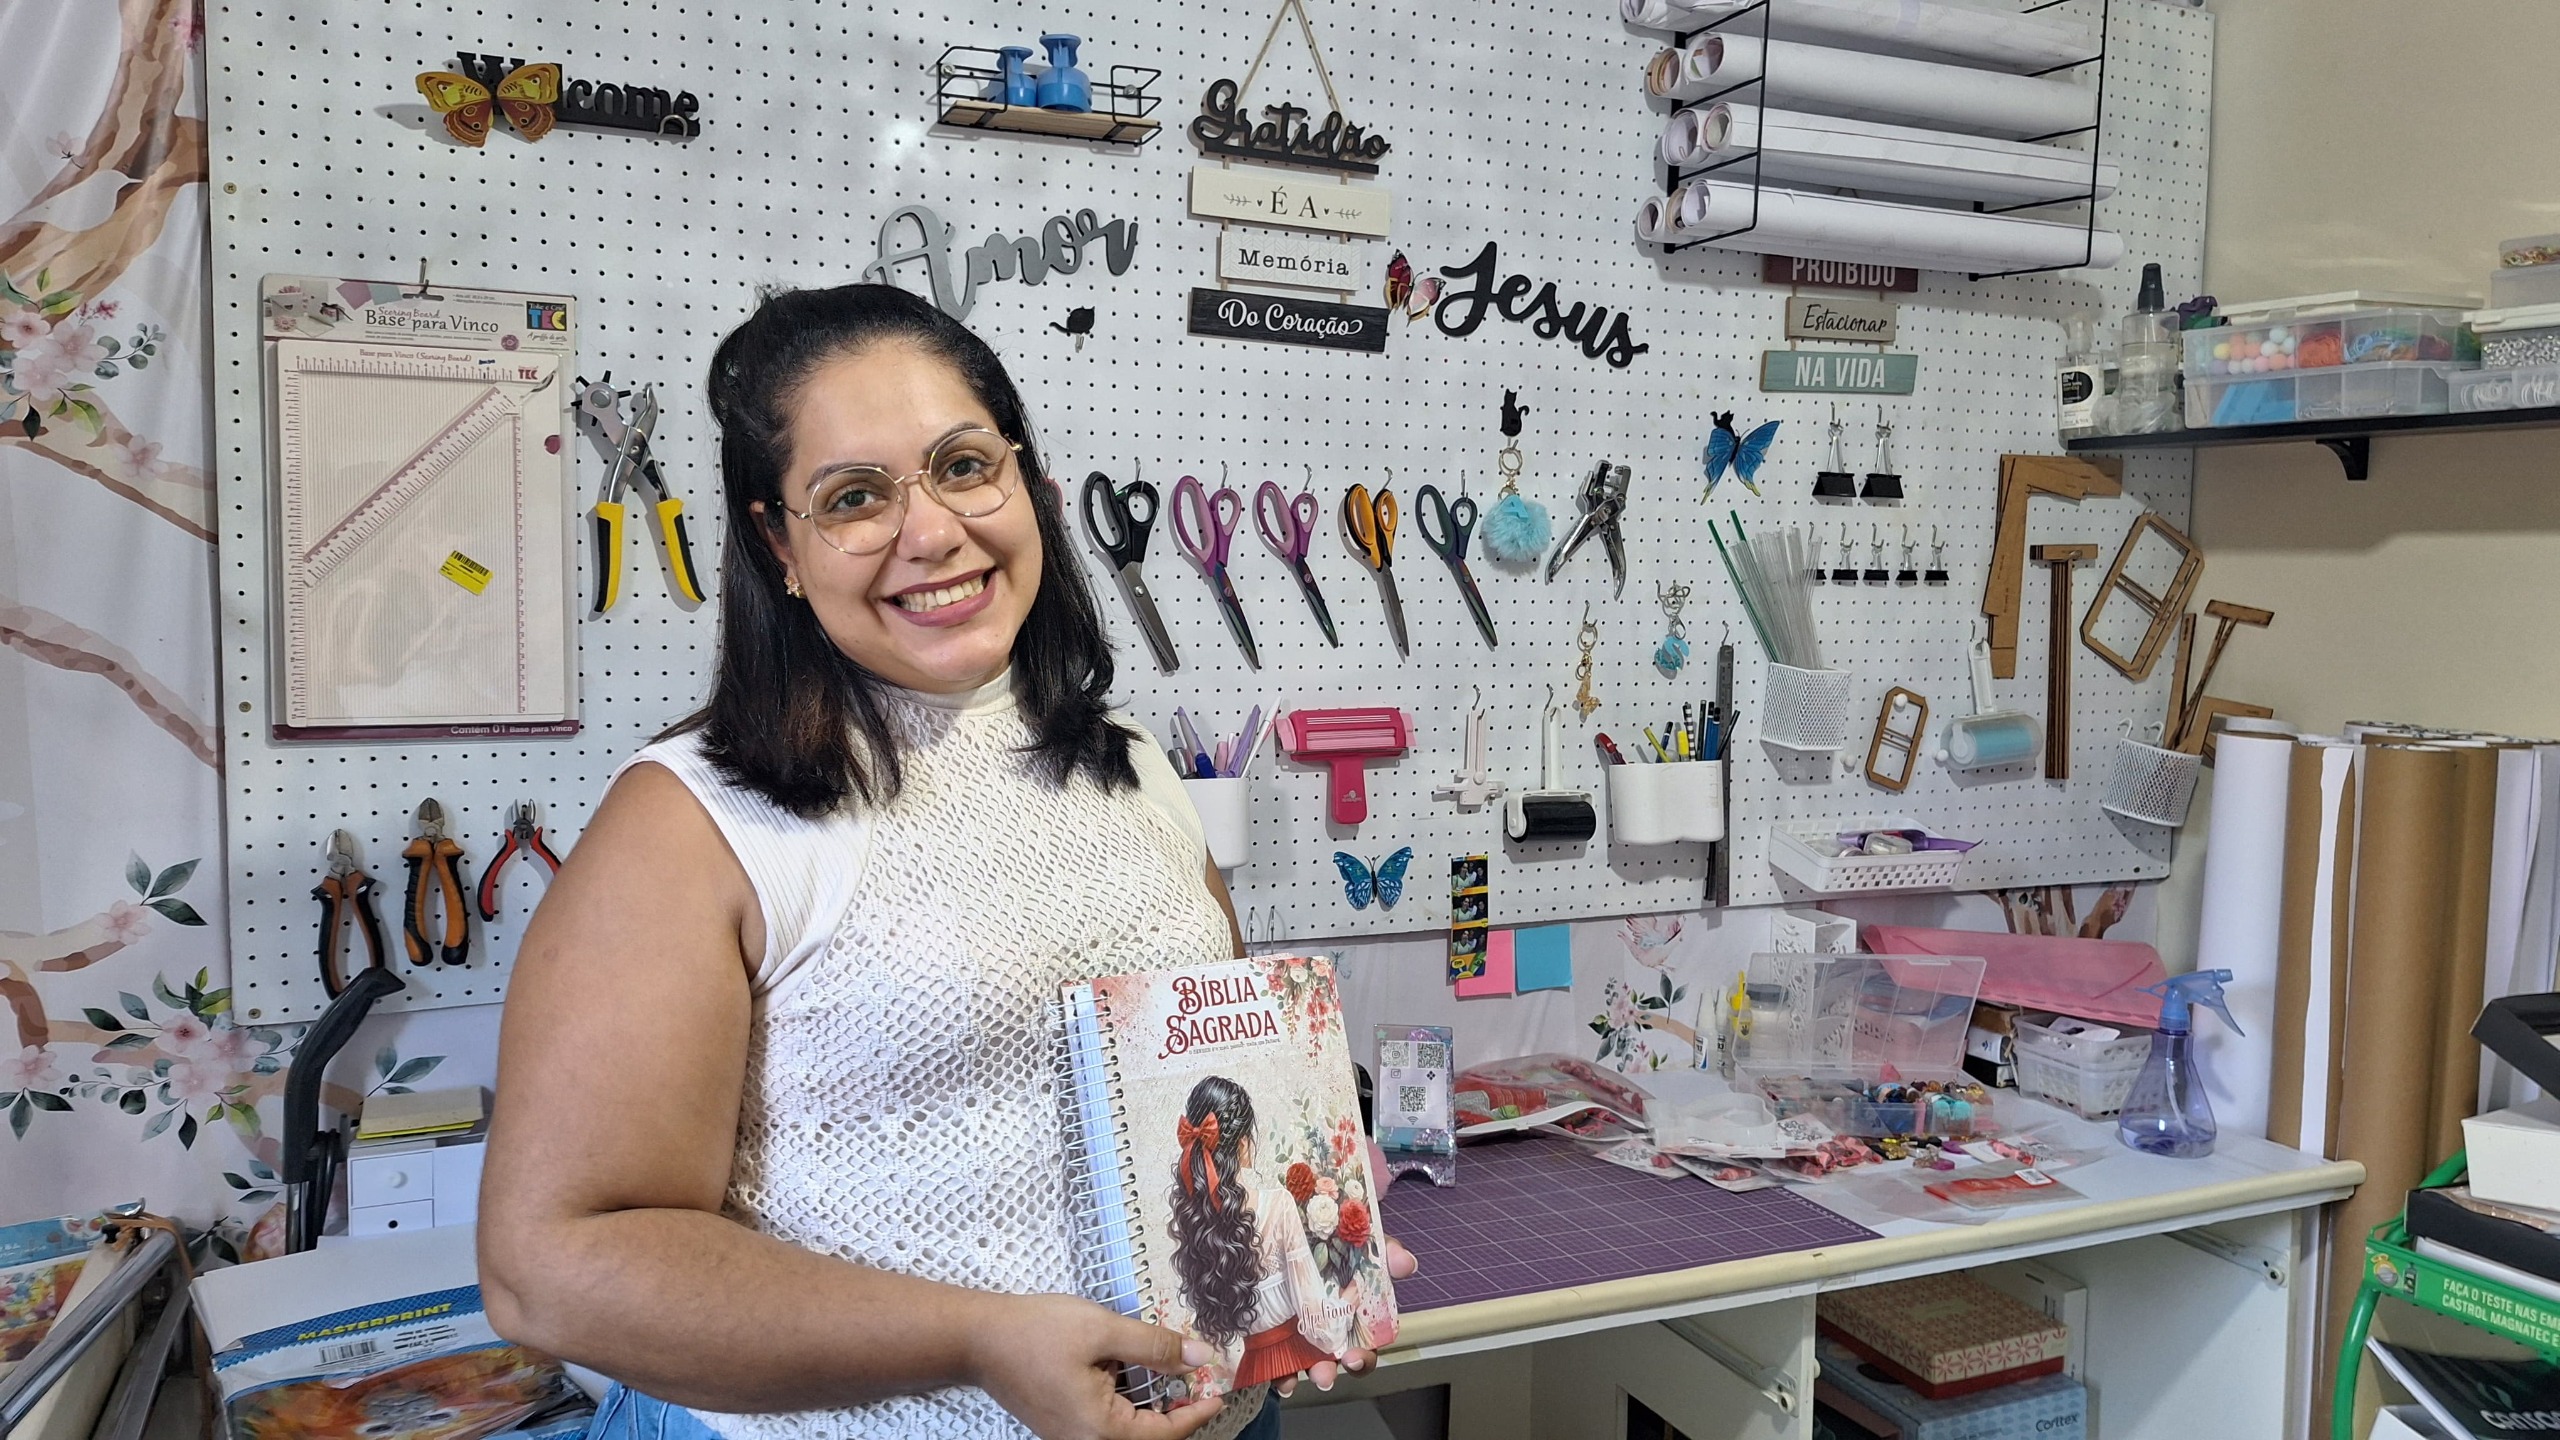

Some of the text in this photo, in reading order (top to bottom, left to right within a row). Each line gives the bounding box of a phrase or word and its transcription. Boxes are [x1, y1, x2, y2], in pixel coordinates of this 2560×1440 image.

[457, 51, 700, 128] Wcome
[1193, 79, 1391, 162] Gratidão
[1270, 186, 1318, 218] É A
[862, 205, 1138, 321] Amor
[1238, 249, 1349, 275] Memória
[365, 309, 499, 333] Base para Vinco
[378, 307, 440, 319] Scoring Board
[528, 309, 565, 330] TEC
[1218, 299, 1363, 339] Do Coração
[1435, 241, 1649, 368] Jesus
[1803, 304, 1887, 333] Estacionar
[518, 369, 538, 379] TEC
[1795, 357, 1885, 388] NA VIDA
[492, 724, 506, 733] 01
[1172, 974, 1258, 1015] BÍBLIA
[1158, 1010, 1279, 1060] SAGRADA
[2442, 1294, 2488, 1321] CASTROL
[2490, 1311, 2551, 1343] MAGNATEC
[2443, 1278, 2469, 1298] FAÇA
[2471, 1288, 2479, 1301] O
[2481, 1291, 2513, 1313] TESTE
[2515, 1303, 2537, 1322] NAS
[297, 1303, 452, 1340] MASTERPRINT
